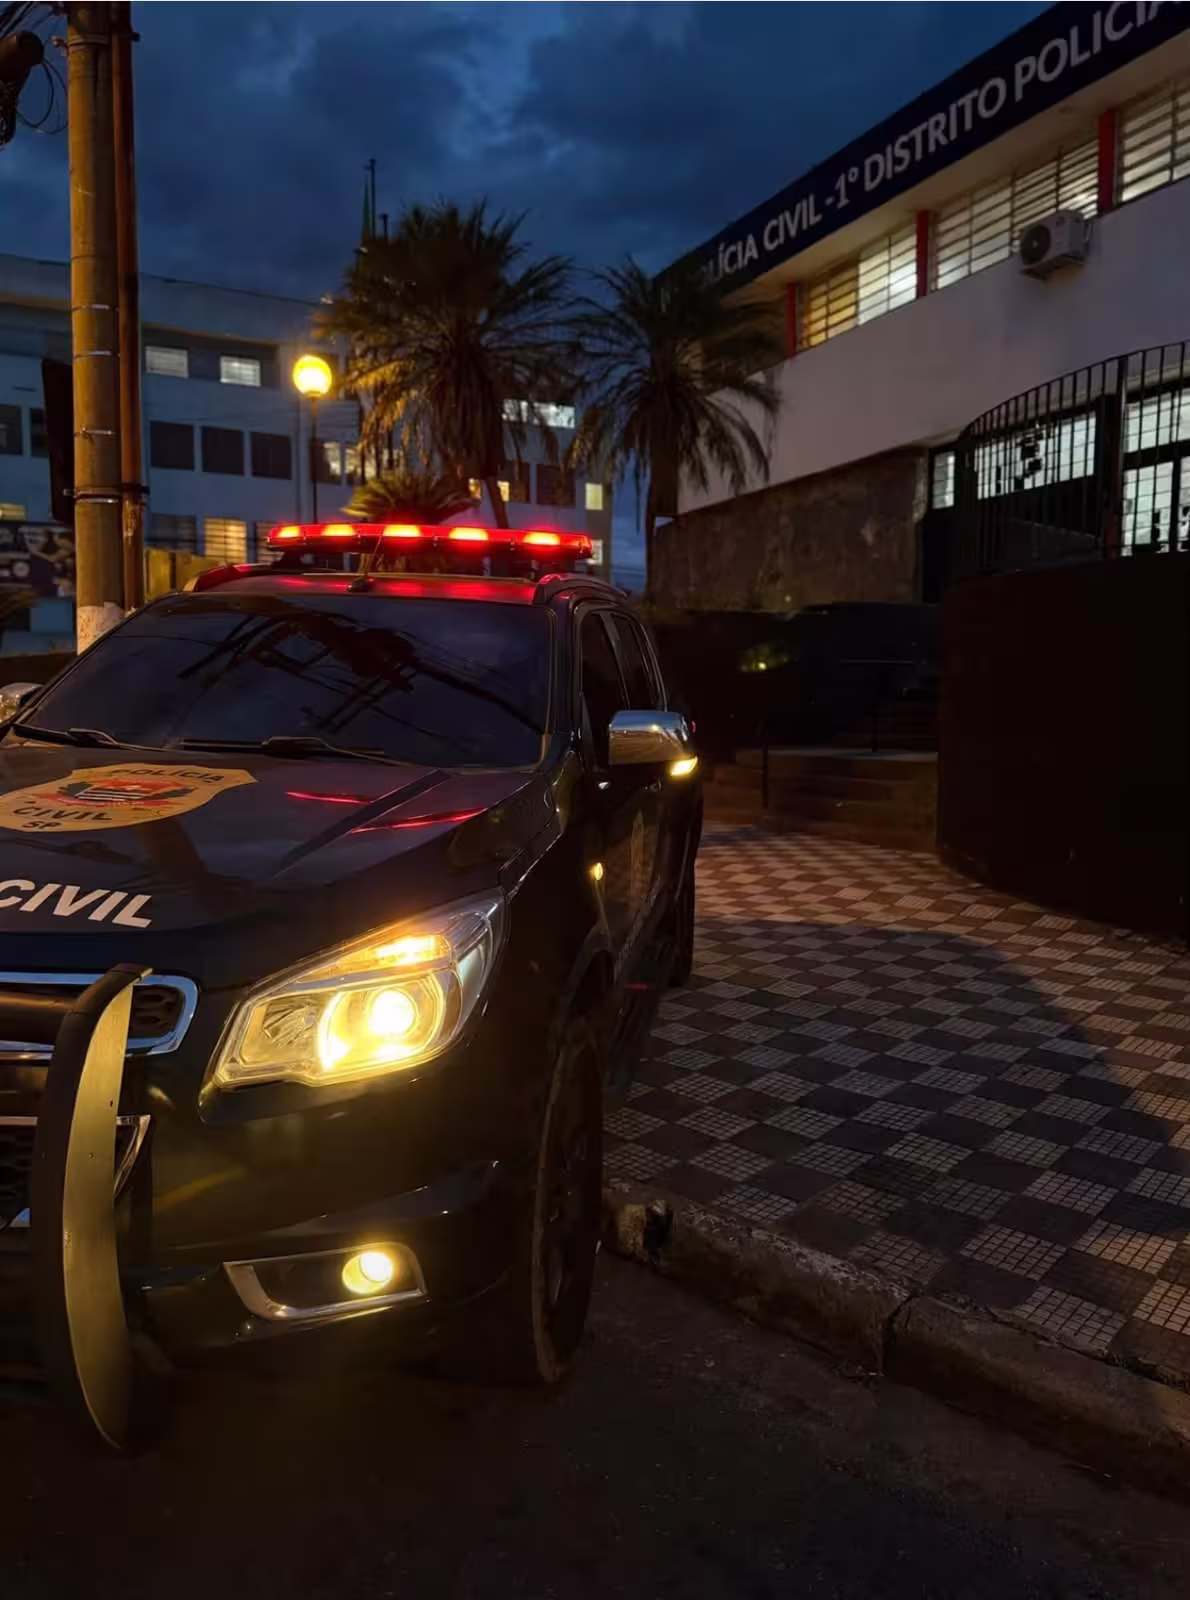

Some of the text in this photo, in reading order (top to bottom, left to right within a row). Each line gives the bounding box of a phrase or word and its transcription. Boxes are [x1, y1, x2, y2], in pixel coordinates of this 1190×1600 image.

[762, 192, 824, 252] CIVIL
[863, 75, 1008, 193] DISTRITO
[13, 806, 113, 821] CIVIL
[0, 879, 153, 929] CIVIL
